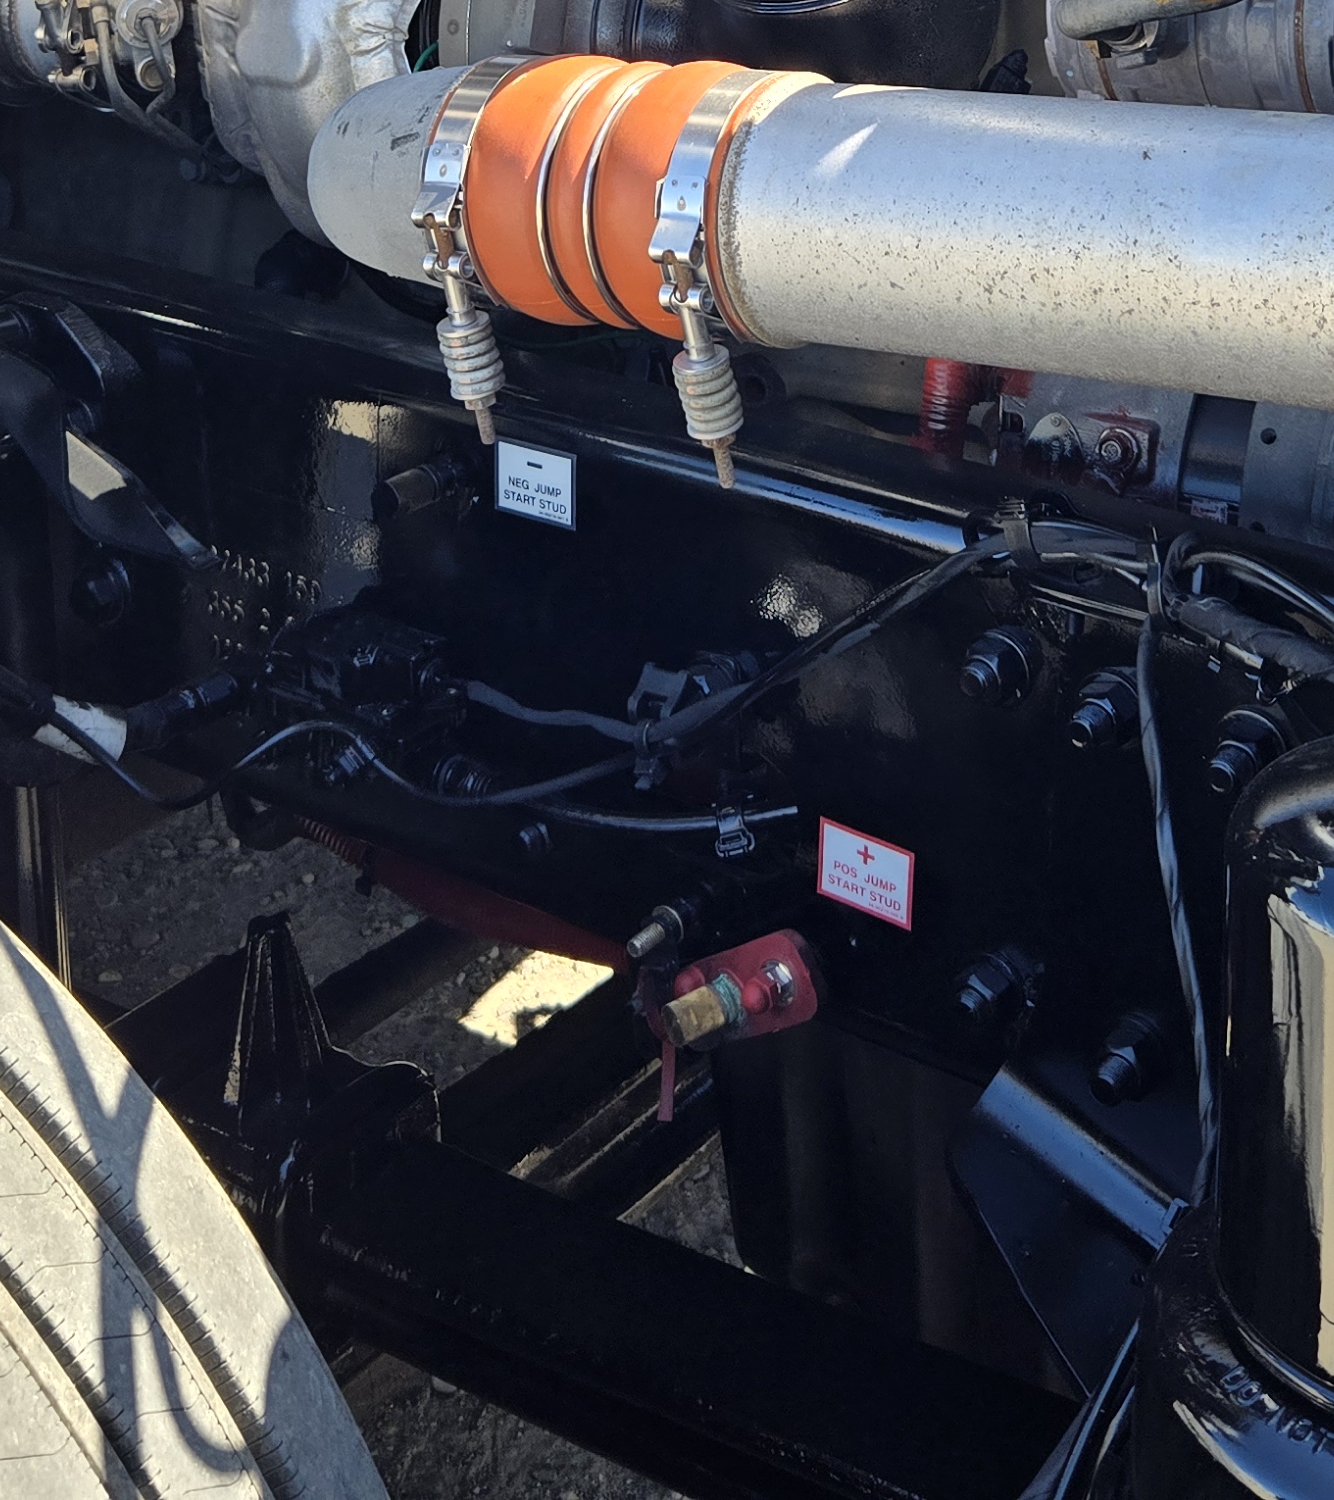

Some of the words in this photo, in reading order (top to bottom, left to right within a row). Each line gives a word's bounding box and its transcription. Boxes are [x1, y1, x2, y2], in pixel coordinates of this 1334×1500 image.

[508, 475, 530, 490] NEG
[534, 483, 562, 498] JUMP
[503, 489, 536, 507] START
[539, 498, 567, 515] STUD
[833, 860, 858, 878] POS
[864, 873, 897, 893] JUMP
[828, 873, 866, 897] START
[869, 891, 902, 912] STUD
